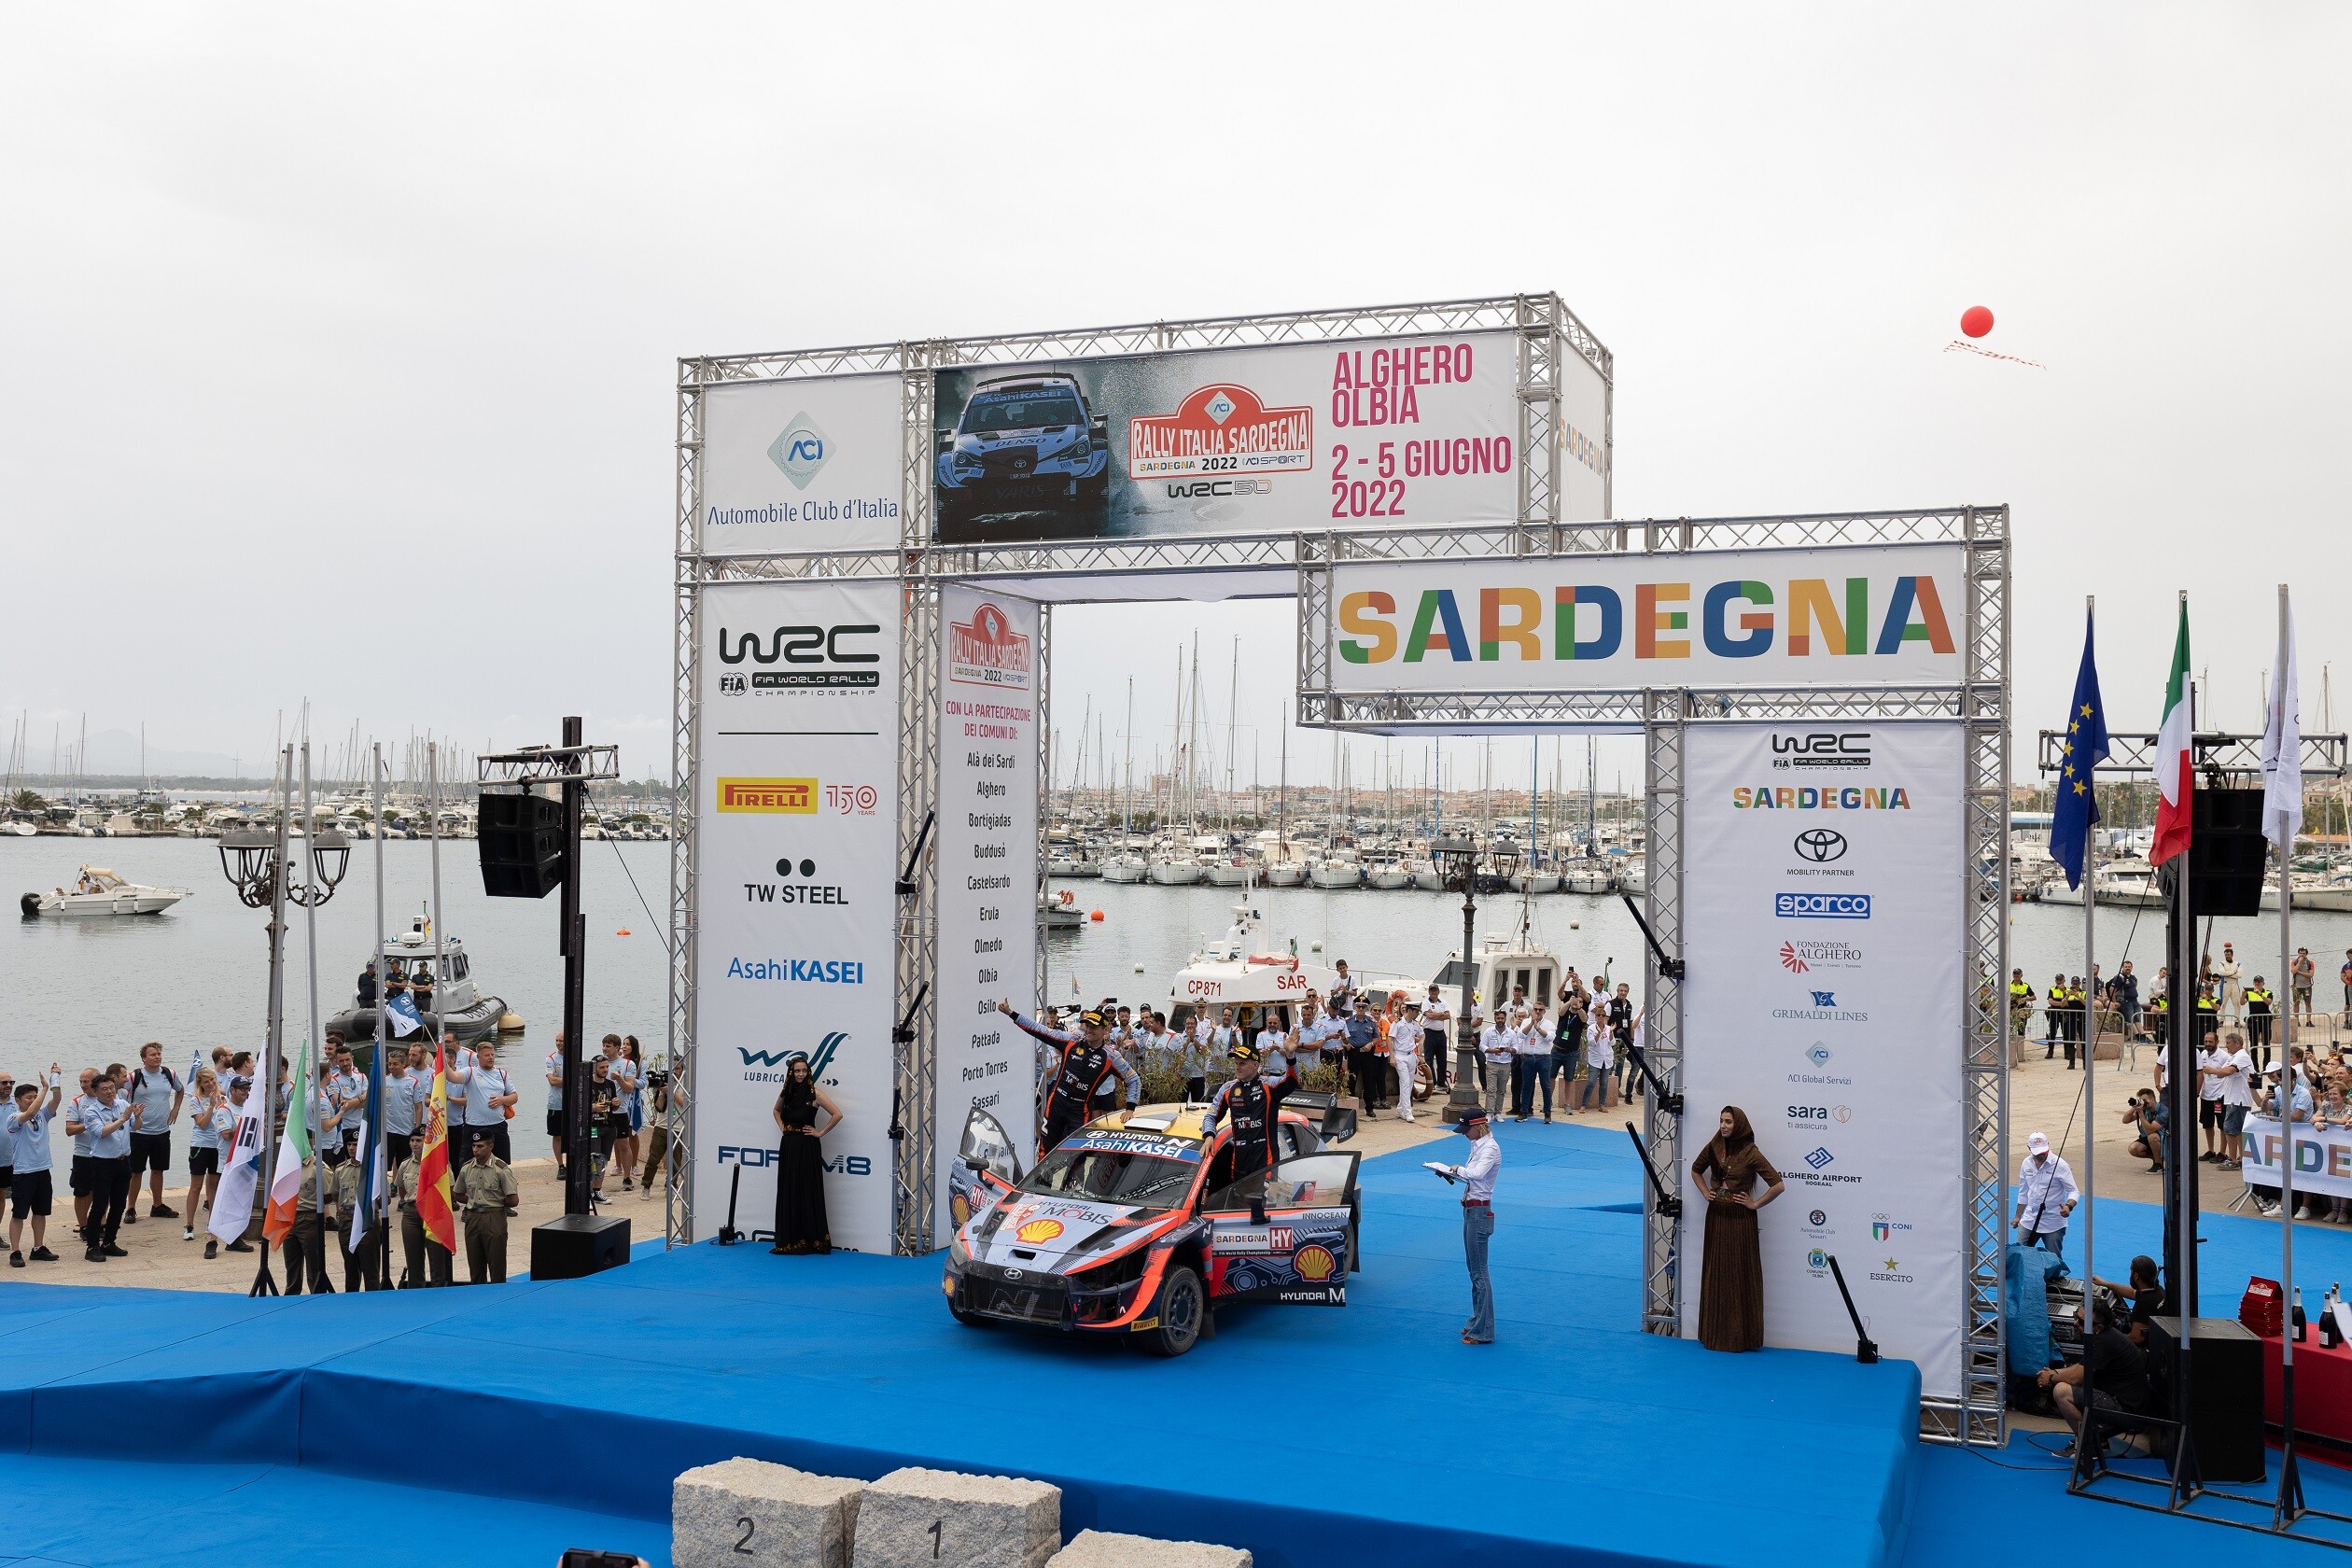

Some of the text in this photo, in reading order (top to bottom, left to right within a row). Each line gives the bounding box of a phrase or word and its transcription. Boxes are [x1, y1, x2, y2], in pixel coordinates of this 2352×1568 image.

[1333, 343, 1473, 390] ALGHERO
[1213, 402, 1229, 413] ACI
[1332, 385, 1420, 427] OLBIA
[995, 438, 1046, 447] DENSO
[1133, 412, 1309, 458] RALLY ITALIA SARDEGNA
[788, 439, 823, 462] ACI
[1560, 417, 1603, 479] SARDEGNA
[1140, 460, 1196, 471] SARDEGNA
[1201, 457, 1238, 470] 2022
[1332, 444, 1349, 481] 2
[1379, 441, 1394, 478] 5
[1405, 436, 1512, 478] GIUGNO
[1332, 479, 1406, 518] 2022
[707, 497, 898, 526] Automobile Club d'Italia
[1338, 575, 1956, 665] SARDEGNA
[720, 624, 880, 664] WRC
[952, 627, 1030, 672] RALLY ITALIA SARDEGNA
[984, 668, 1002, 682] 2022
[946, 700, 1031, 722] CON LA PARTECIPAZIONE
[964, 722, 1017, 740] DEI COMUNI DI:
[1771, 733, 1871, 753] WRC
[967, 750, 1015, 769] Alà dei Sardi
[725, 784, 809, 806] PIRELLI
[976, 780, 1006, 799] Alghero
[1733, 787, 1911, 809] SARDEGNA
[968, 812, 1012, 831] Bortigiadas
[973, 842, 1006, 859] Buddusò
[967, 874, 1011, 890] Castelsardo
[744, 884, 849, 905] TW STEEL
[979, 906, 1000, 921] Erula
[1778, 895, 1868, 916] sparco
[974, 937, 1002, 954] Olmedo
[1797, 941, 1850, 949] FONDAZIONE
[1798, 949, 1861, 960] ALGHERO
[727, 957, 863, 984] AsahiKASEI
[978, 968, 998, 984] Olbia
[1188, 979, 1222, 997] CP871
[1277, 974, 1308, 990] SAR
[978, 999, 997, 1015] Osilo
[1772, 1009, 1868, 1021] GRIMALDI LINES
[972, 1030, 1001, 1049] Pattada
[1813, 1050, 1828, 1058] ACI
[744, 1071, 785, 1084] LUBRICA
[962, 1060, 1008, 1083] Porto Torres
[1787, 1074, 1852, 1085] ACI Global Servizi
[972, 1090, 1000, 1109] Sassari
[1787, 1105, 1827, 1119] sara
[1238, 1119, 1262, 1129] MOBIS
[1110, 1132, 1164, 1142] HYUNDAI
[1080, 1140, 1183, 1158] AsahiKASEI
[718, 1145, 871, 1176] FORM8
[1777, 1171, 1862, 1183] ALGHERO AIRPORT
[1038, 1201, 1091, 1211] HYUNDAI
[1042, 1207, 1113, 1225] MOBIS
[1216, 1228, 1292, 1248] SARDEGNA HY
[1869, 1272, 1913, 1283] ESERCITO
[1281, 1292, 1325, 1301] HYUNDAI
[1133, 1318, 1156, 1329] PIRELLI
[734, 1517, 756, 1555] 2
[928, 1520, 943, 1560] 1
